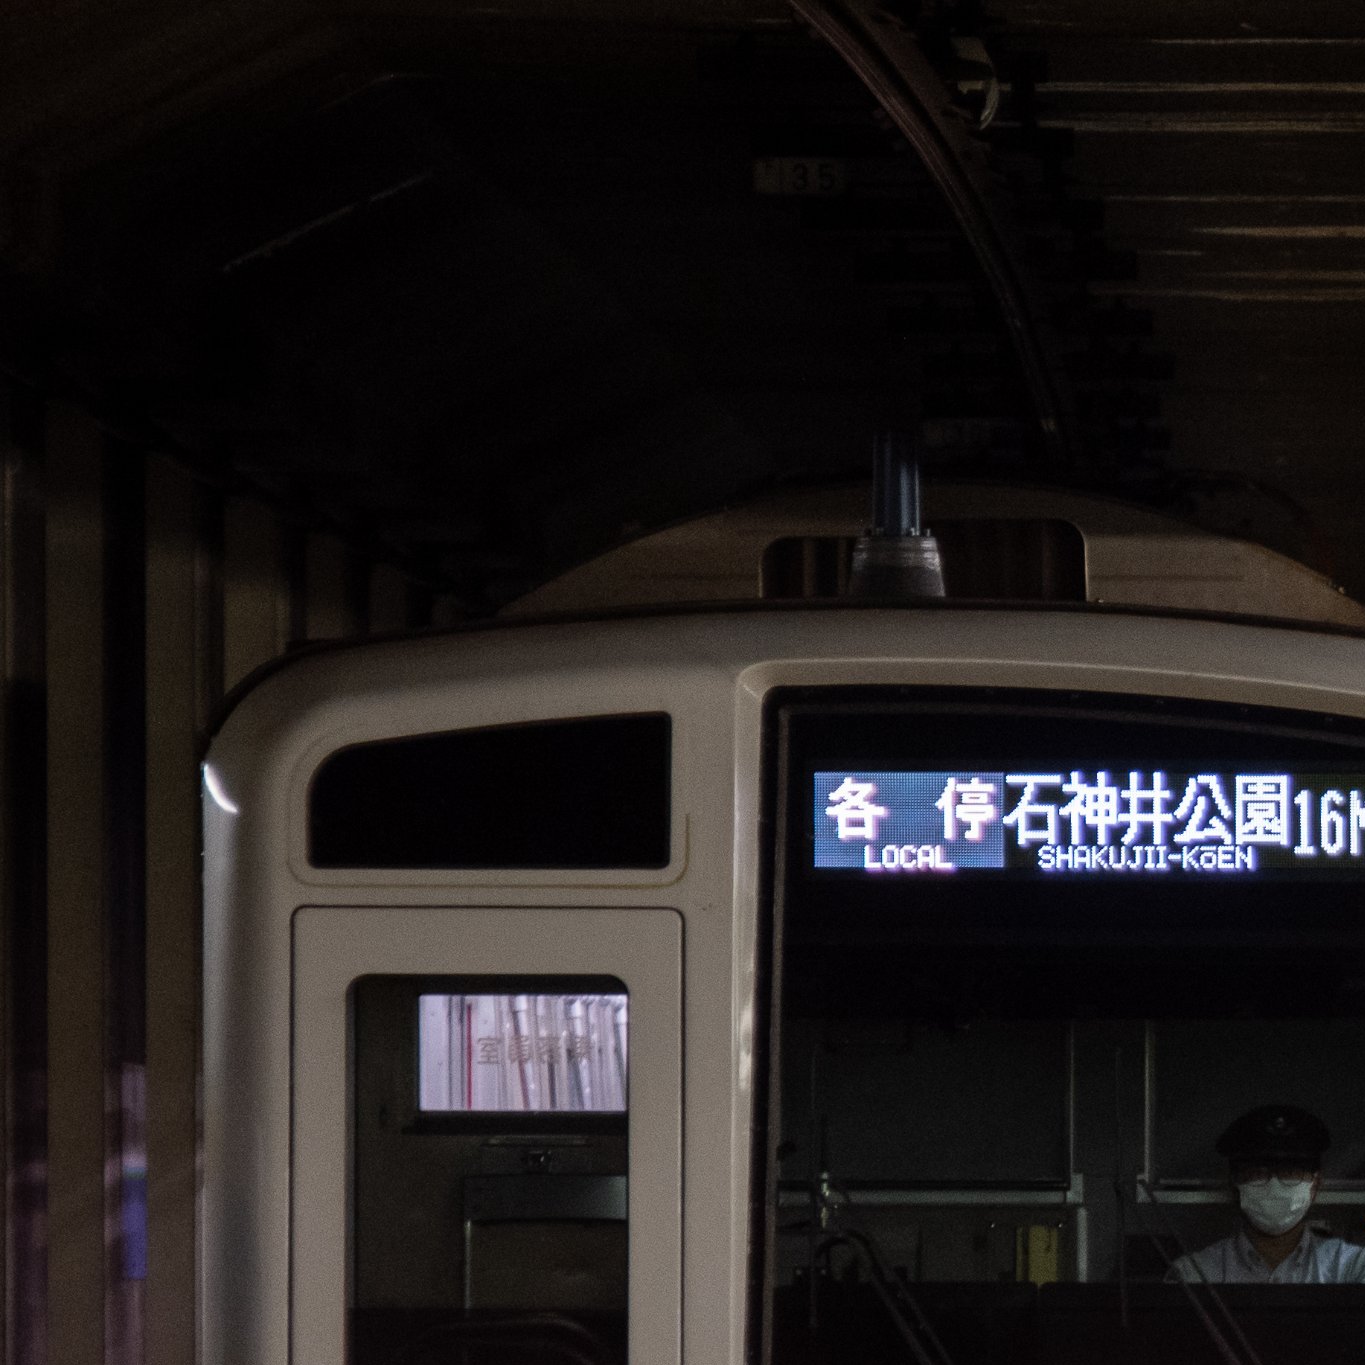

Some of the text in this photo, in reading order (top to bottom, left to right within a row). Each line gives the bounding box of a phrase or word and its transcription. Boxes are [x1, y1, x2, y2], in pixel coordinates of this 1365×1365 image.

[1002, 771, 1293, 847] 石神井公園
[862, 844, 956, 870] LOCAL
